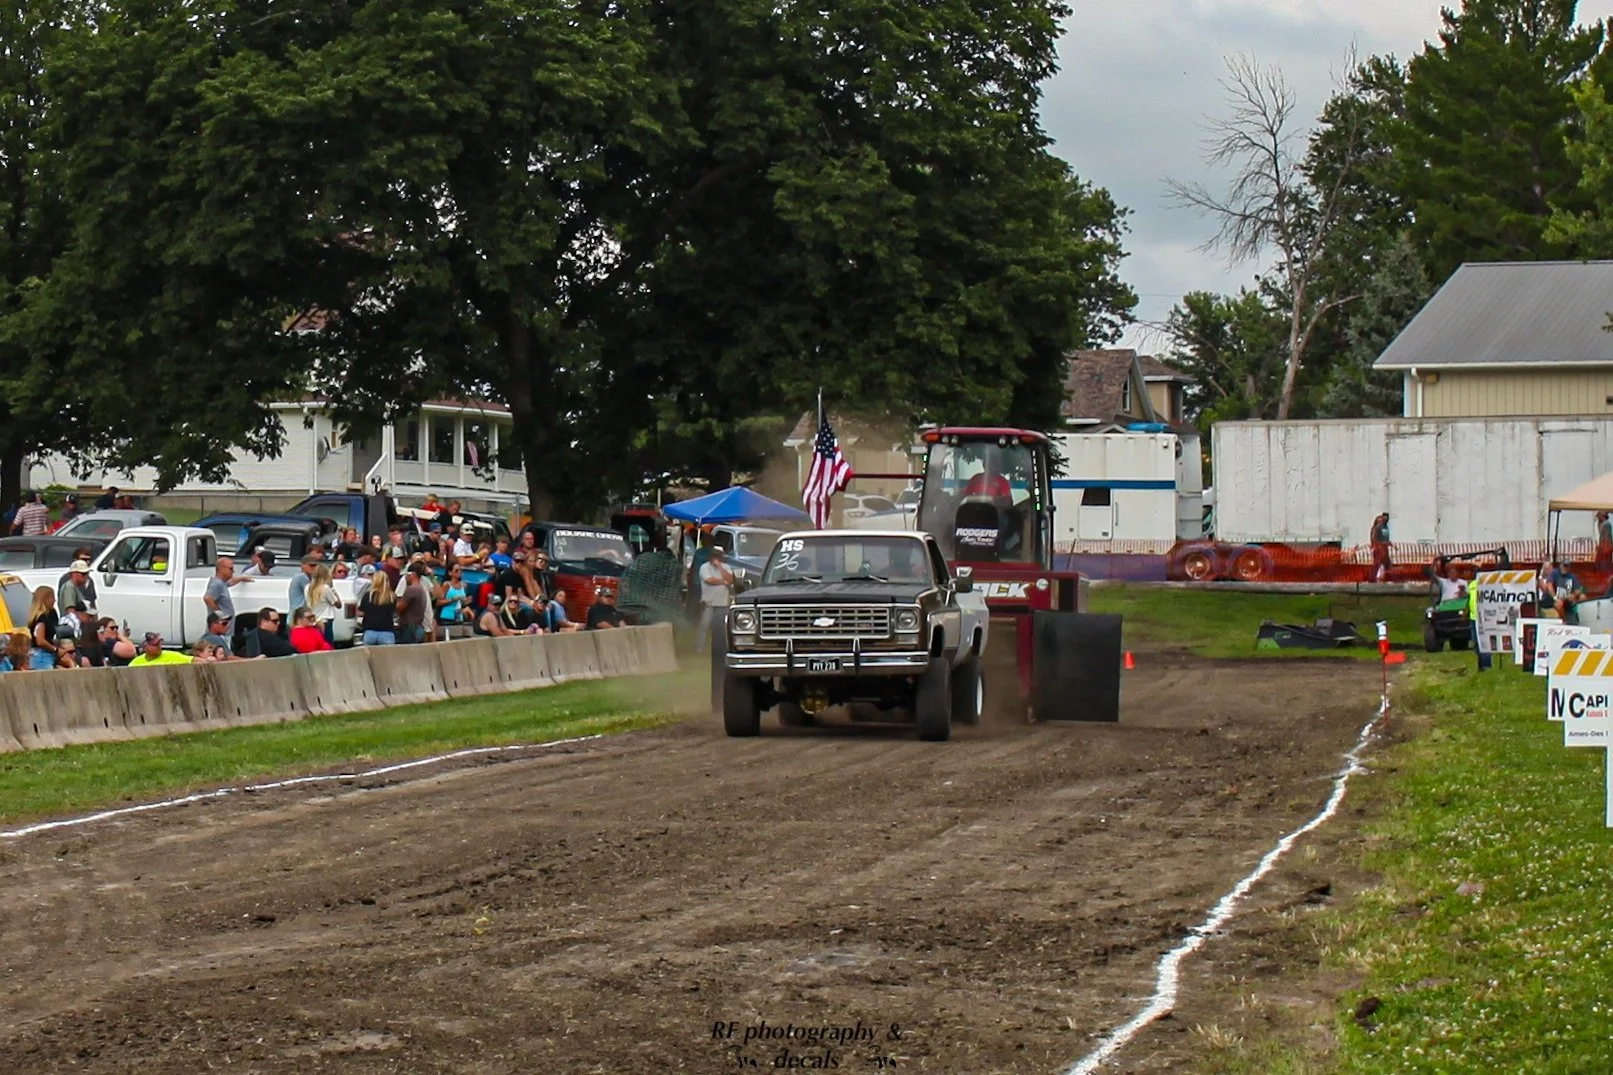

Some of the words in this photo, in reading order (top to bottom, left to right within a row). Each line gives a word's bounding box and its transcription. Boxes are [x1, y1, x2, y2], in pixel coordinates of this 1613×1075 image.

[956, 528, 998, 537] RODGERS
[780, 540, 804, 552] HS
[773, 553, 799, 570] 36
